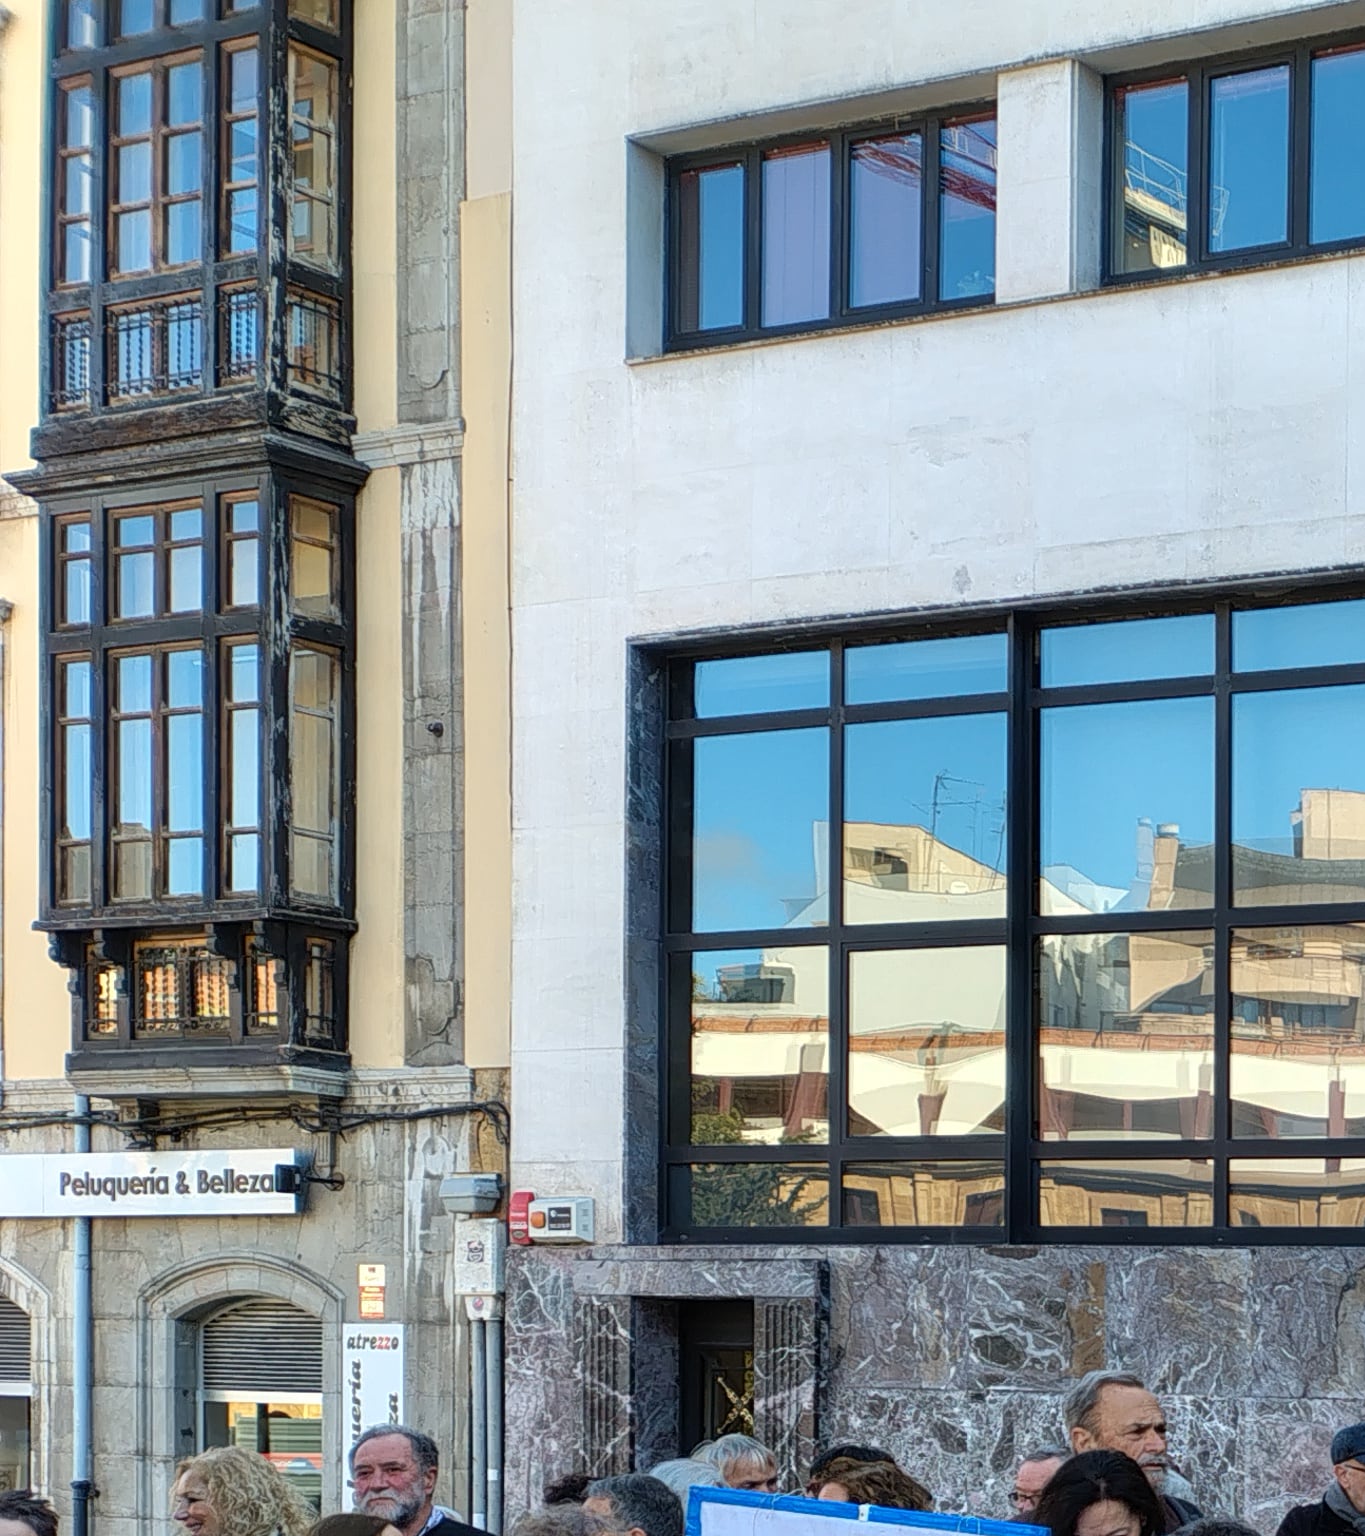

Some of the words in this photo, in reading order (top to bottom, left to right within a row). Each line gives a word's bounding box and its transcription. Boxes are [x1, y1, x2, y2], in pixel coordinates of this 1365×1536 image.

[59, 1167, 169, 1201] Peluquería
[174, 1171, 190, 1194] &
[197, 1168, 276, 1193] Belleza
[346, 1332, 400, 1350] atrezzo
